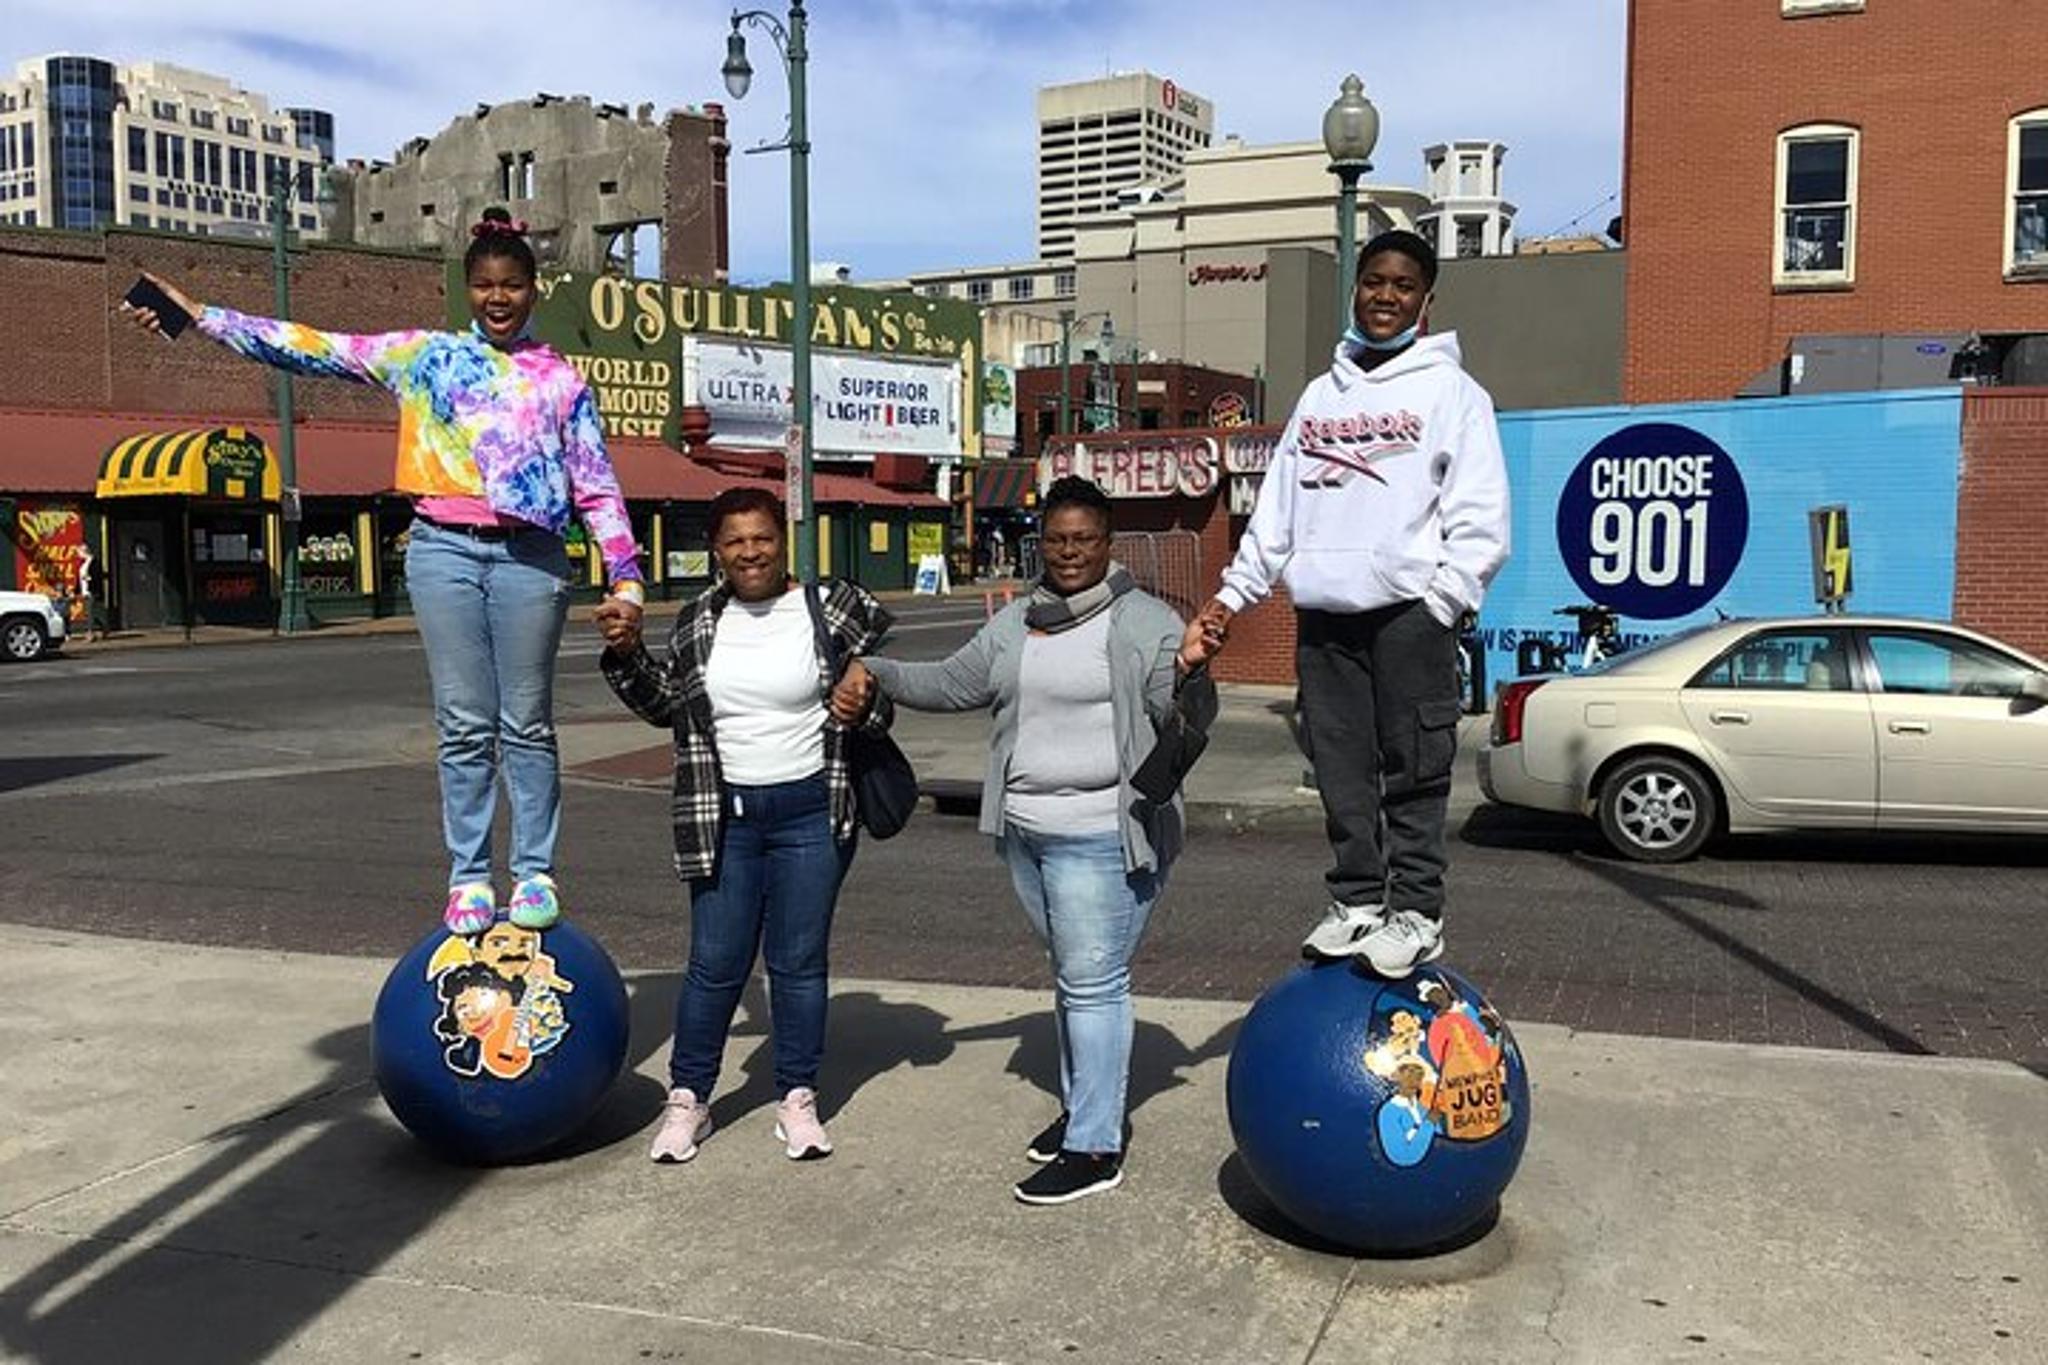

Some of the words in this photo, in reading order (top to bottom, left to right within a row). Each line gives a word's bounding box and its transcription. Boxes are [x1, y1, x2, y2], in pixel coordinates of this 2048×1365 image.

[598, 386, 670, 416] MOUS
[708, 379, 780, 403] ULTRA
[840, 377, 929, 402] SUPERIOR
[827, 400, 880, 422] LIGHT
[898, 407, 940, 426] BEER
[1051, 442, 1212, 493] AFRED'S
[1591, 454, 1713, 498] CHOOSE
[1589, 499, 1708, 586] 901
[1501, 629, 1517, 651] IS
[1451, 1083, 1497, 1110] JUG
[1452, 1109, 1500, 1129] BAND
